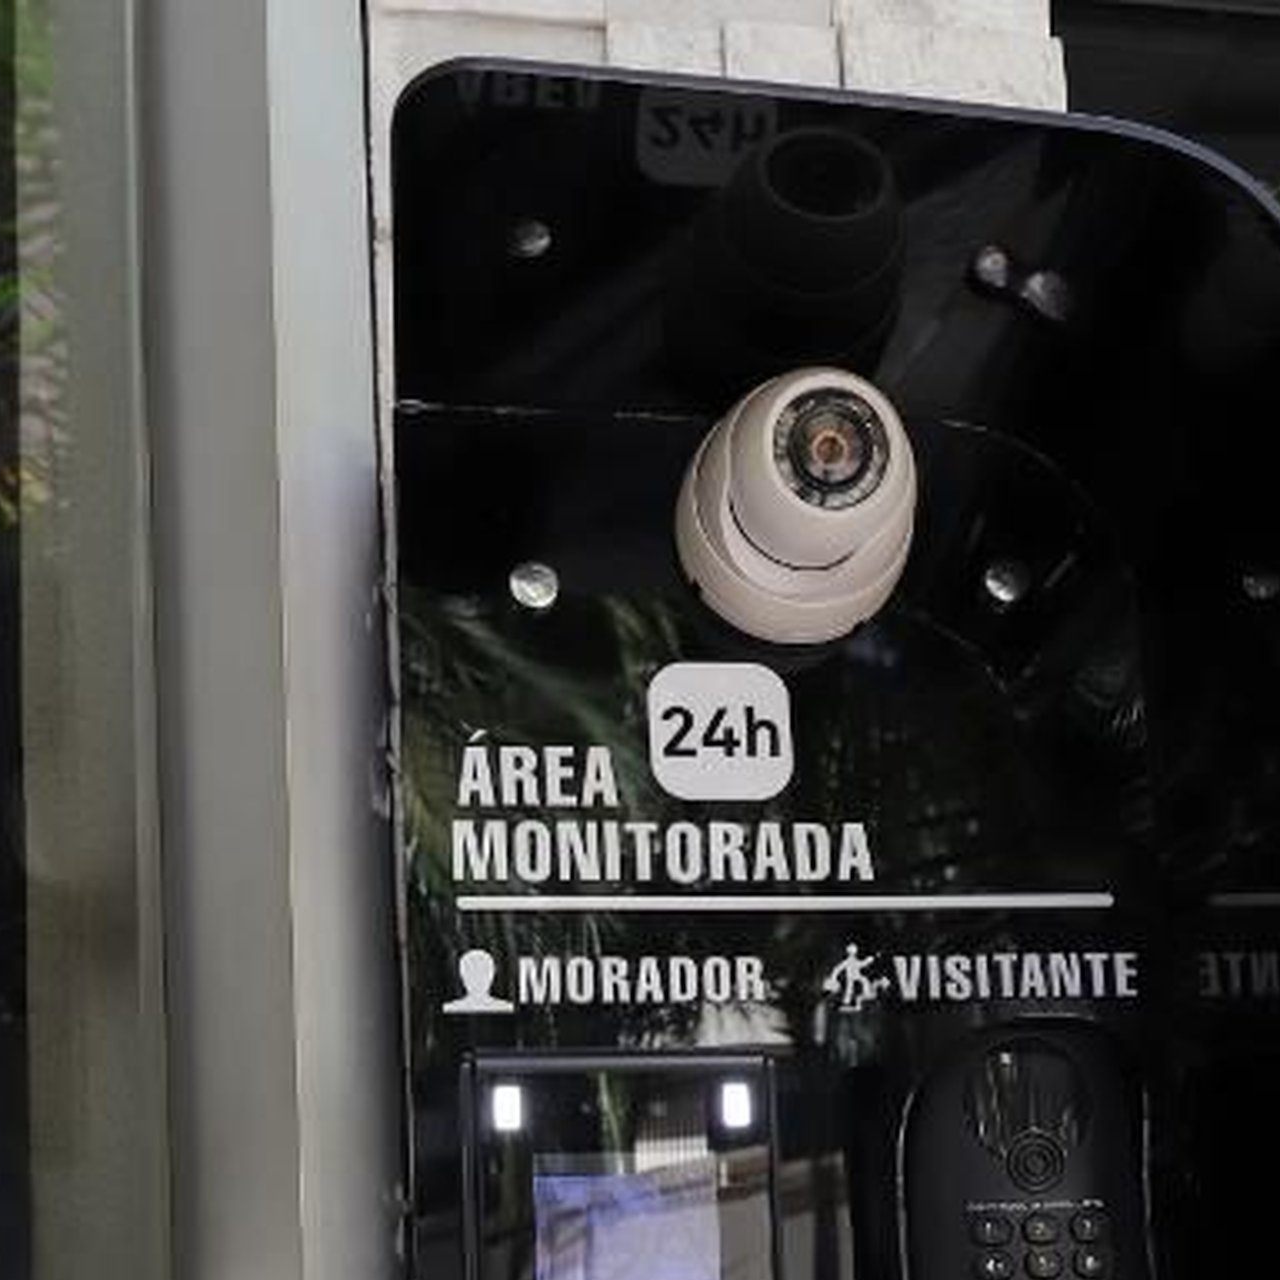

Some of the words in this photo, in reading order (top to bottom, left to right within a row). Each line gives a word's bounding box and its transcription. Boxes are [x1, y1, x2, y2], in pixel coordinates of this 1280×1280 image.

[660, 705, 781, 758] 24h
[457, 728, 620, 808] ÁREA
[451, 819, 875, 883] MONITORADA
[519, 955, 766, 1004] MORADOR
[892, 951, 1139, 1000] VISITANTE
